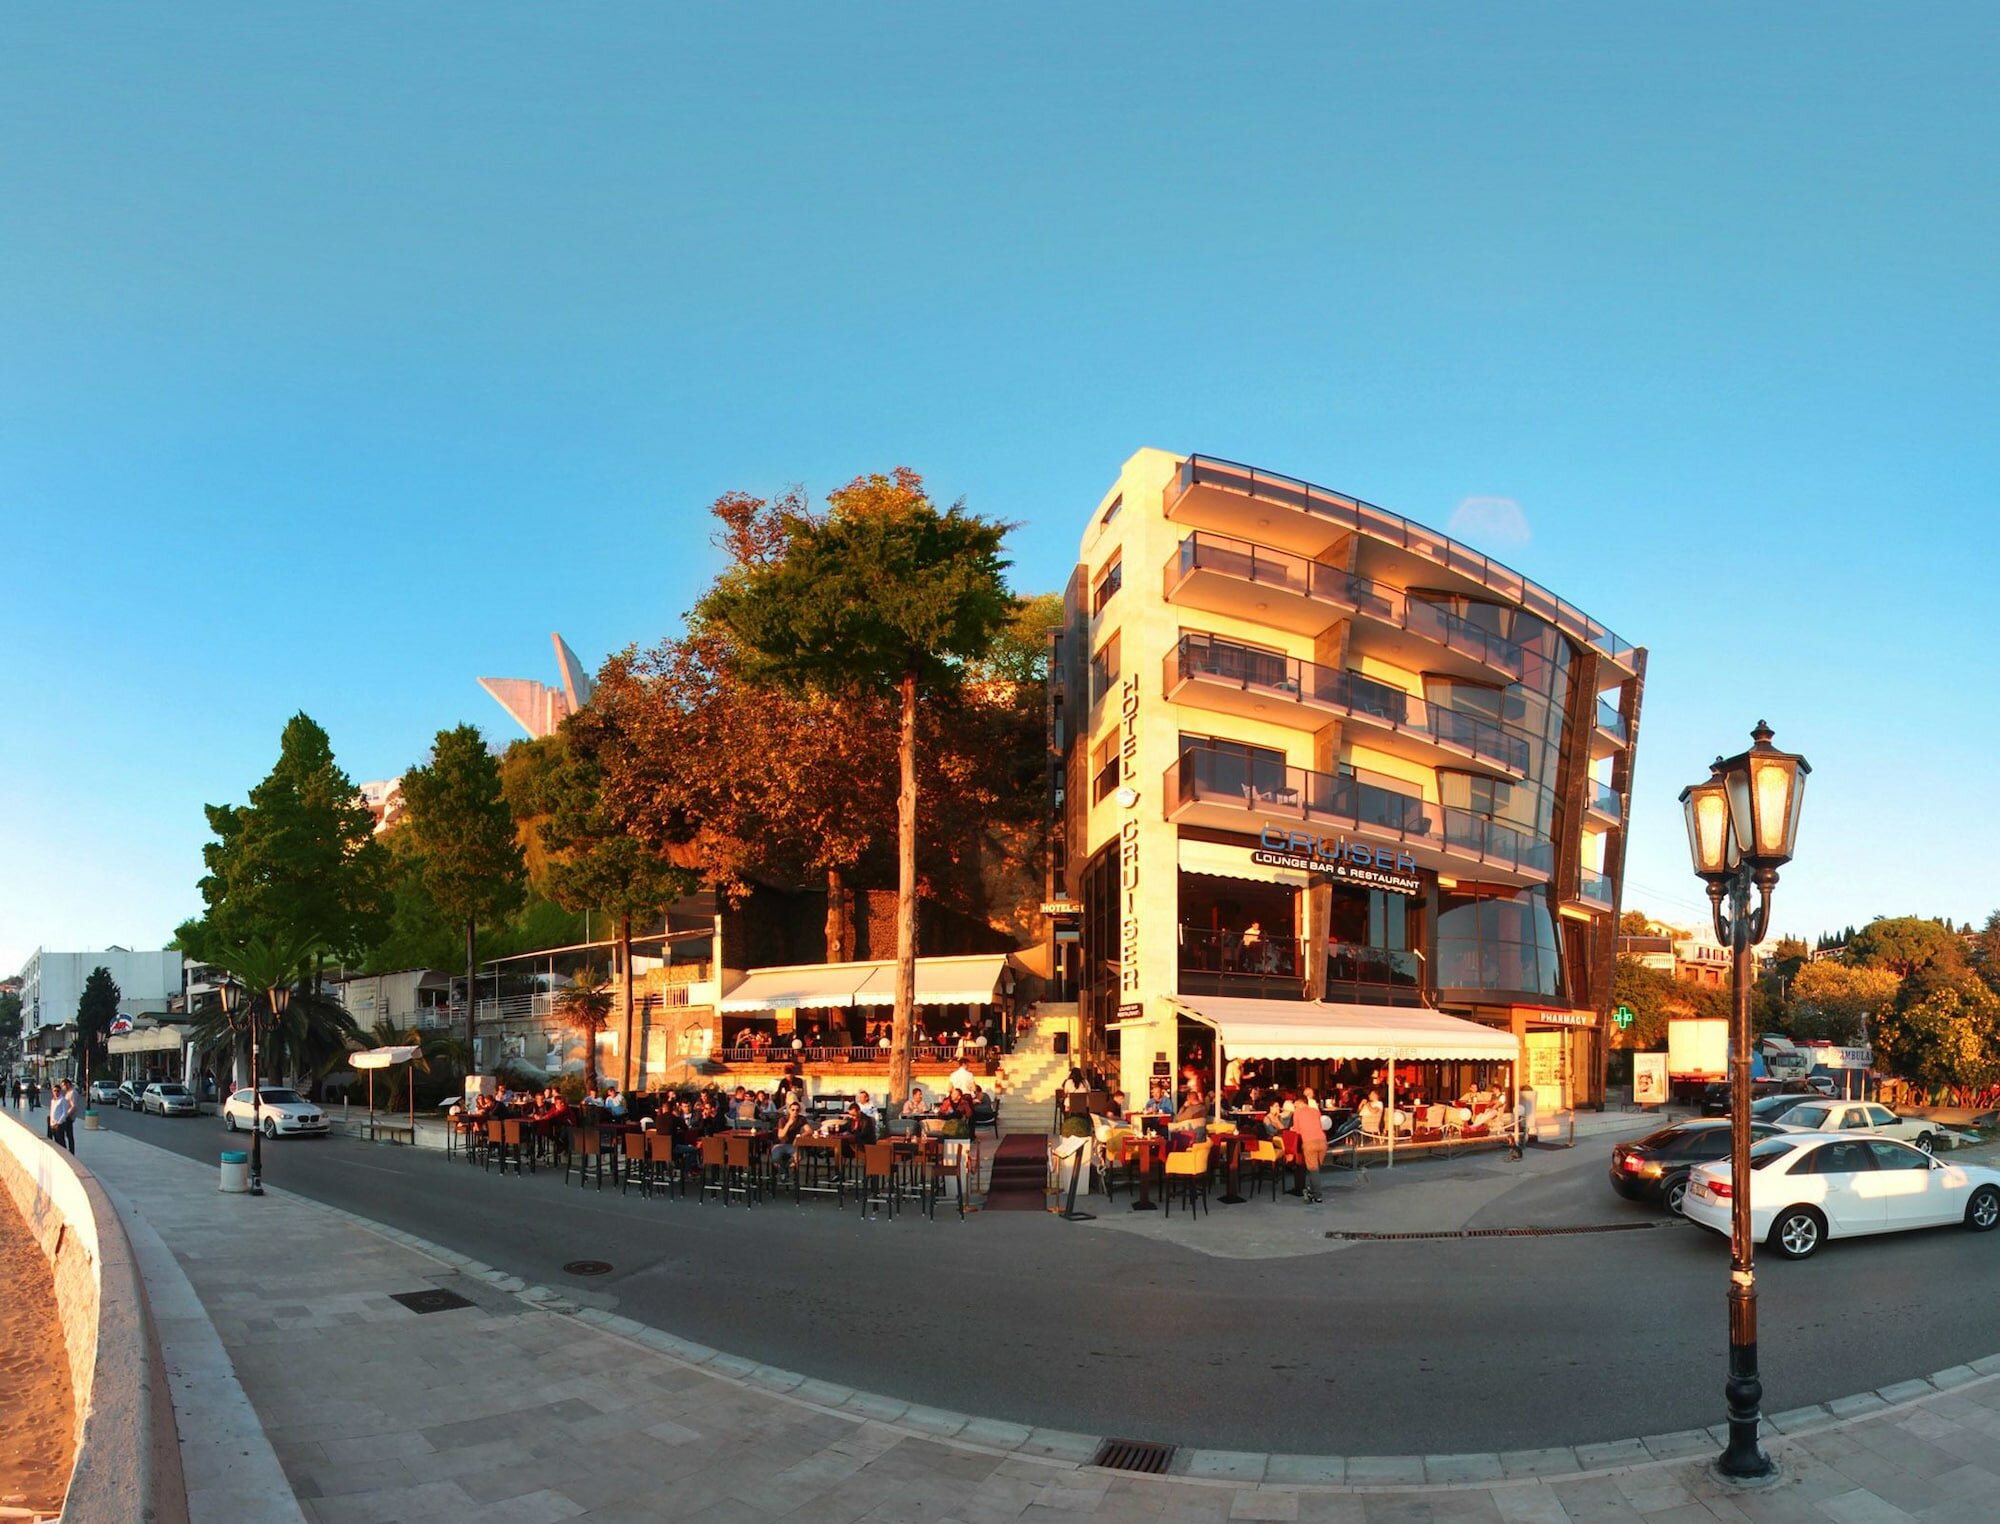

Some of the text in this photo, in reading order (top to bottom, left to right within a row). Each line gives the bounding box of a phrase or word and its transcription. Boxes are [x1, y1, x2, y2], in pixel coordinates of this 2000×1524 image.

[1122, 673, 1139, 781] HOTEL
[1255, 852, 1420, 889] LOUNGE BAR & RESTAURANT
[1260, 825, 1417, 875] CRUISER
[1042, 903, 1073, 914] HOTEL
[1122, 818, 1139, 992] CRUISER
[1540, 1012, 1587, 1026] PHARMACY
